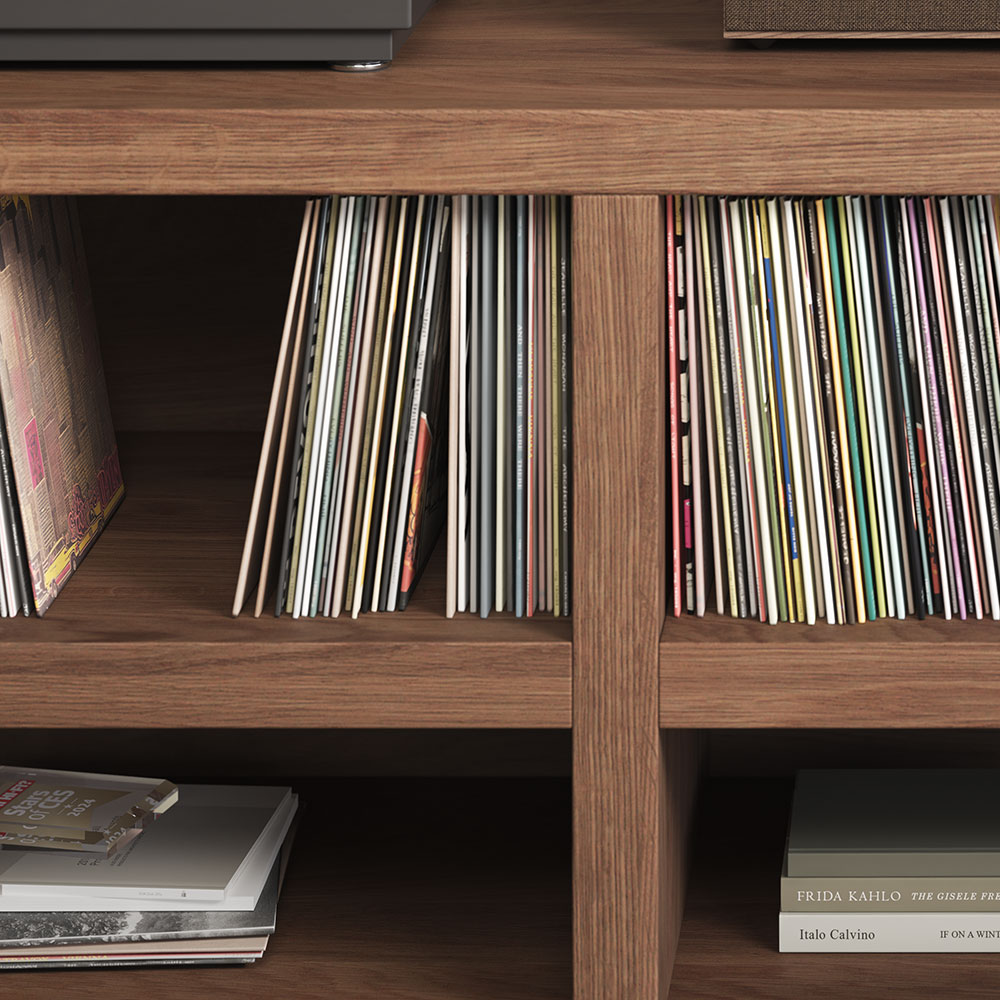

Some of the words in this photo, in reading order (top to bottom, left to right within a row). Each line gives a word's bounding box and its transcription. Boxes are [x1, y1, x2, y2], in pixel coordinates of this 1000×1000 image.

[4, 790, 50, 816] Stars
[38, 789, 75, 809] CES
[66, 798, 96, 817] 2024
[28, 810, 50, 821] of
[797, 890, 842, 902] FRIDA
[849, 890, 901, 902] KAHLO
[912, 892, 932, 901] THE
[937, 892, 977, 901] GISELE
[800, 929, 826, 940] Italo
[830, 929, 875, 940] Calvino
[940, 931, 949, 939] IF
[951, 931, 965, 939] ON
[968, 931, 975, 939] A
